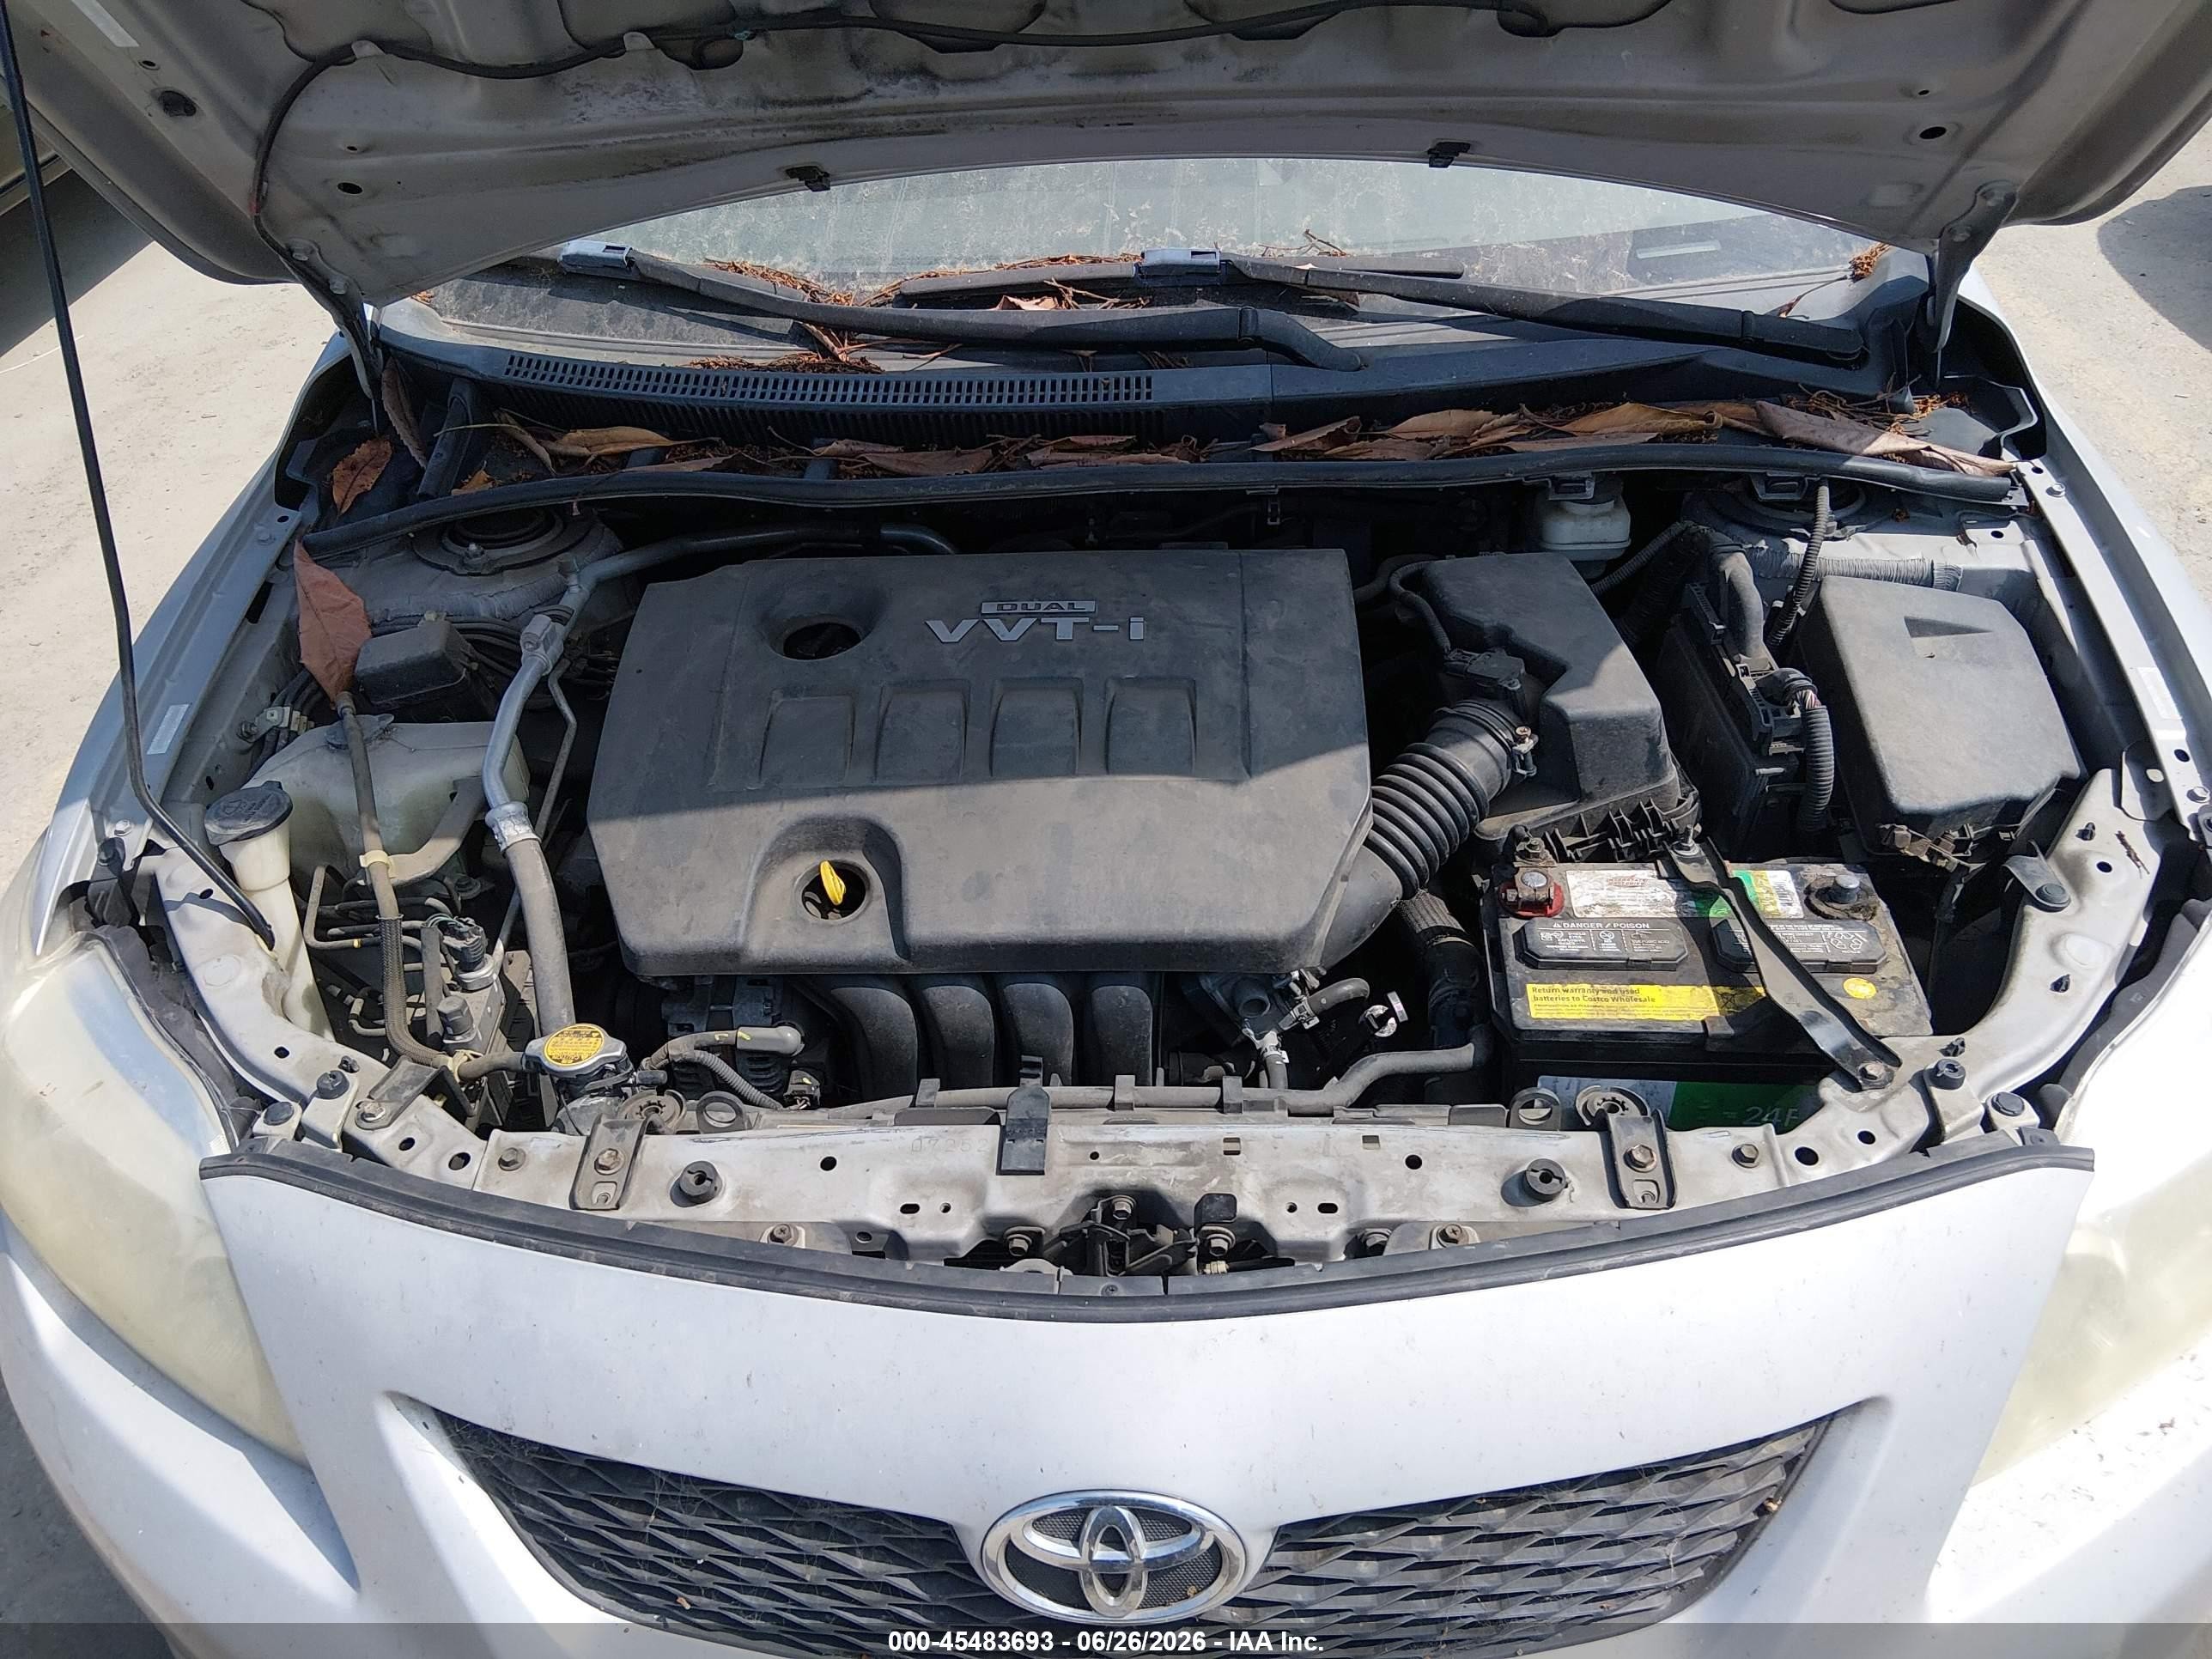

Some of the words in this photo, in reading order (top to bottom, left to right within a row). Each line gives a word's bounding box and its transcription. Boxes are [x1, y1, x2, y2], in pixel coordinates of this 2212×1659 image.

[996, 602, 1086, 611] DUAL
[925, 617, 1145, 643] VVT-i
[1562, 988, 1600, 996] warranty
